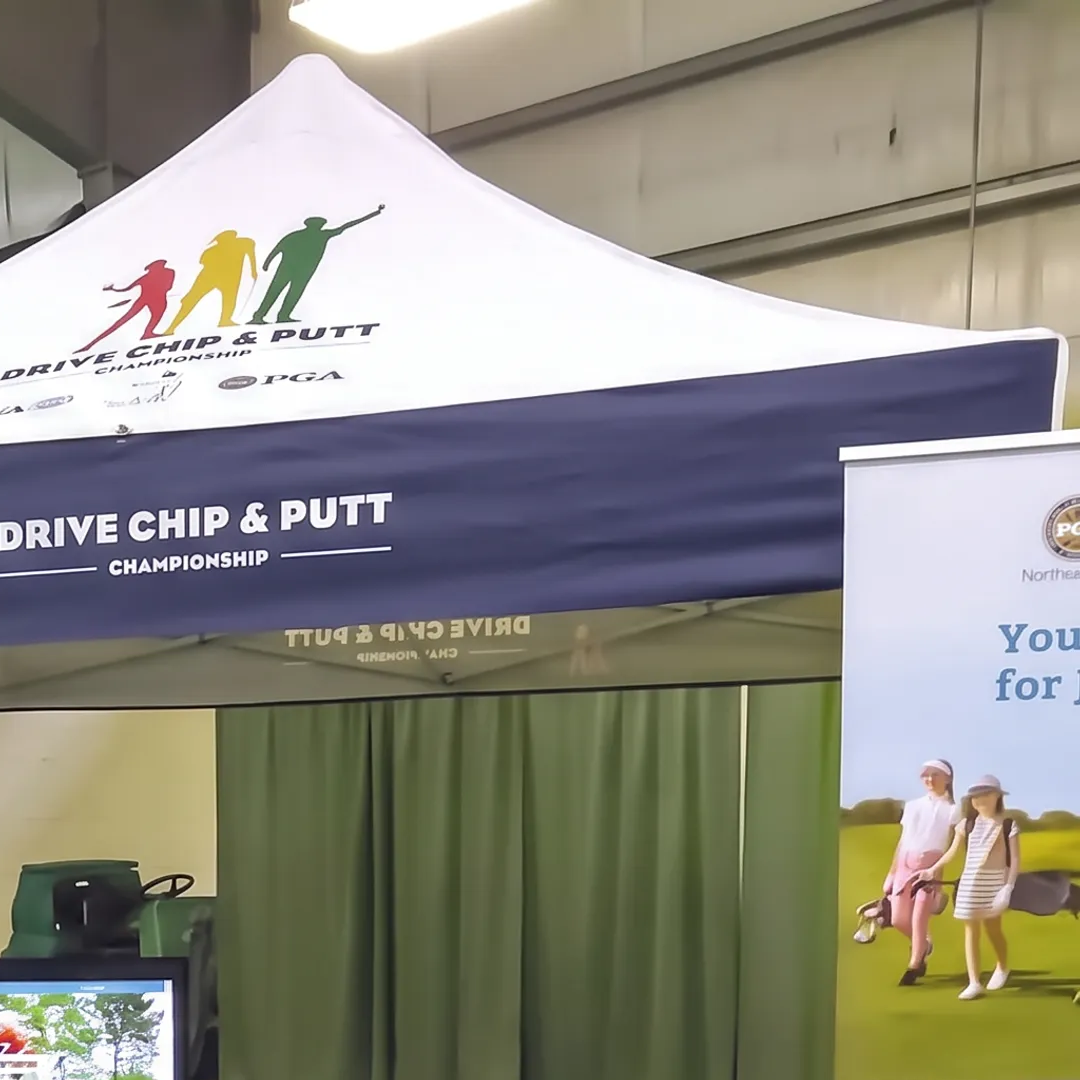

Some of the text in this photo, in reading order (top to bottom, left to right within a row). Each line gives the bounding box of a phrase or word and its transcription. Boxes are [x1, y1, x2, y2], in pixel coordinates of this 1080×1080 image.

[0, 323, 380, 381] DRIVE CHIP & PUTT
[94, 349, 252, 375] CHAMPIONSHIP
[260, 370, 345, 386] PGA
[128, 506, 229, 543] CHIP
[240, 502, 269, 534] &
[280, 492, 393, 531] PUTT
[108, 550, 269, 577] CHAMPIONSHIP
[998, 623, 1080, 654] You
[995, 668, 1062, 701] for
